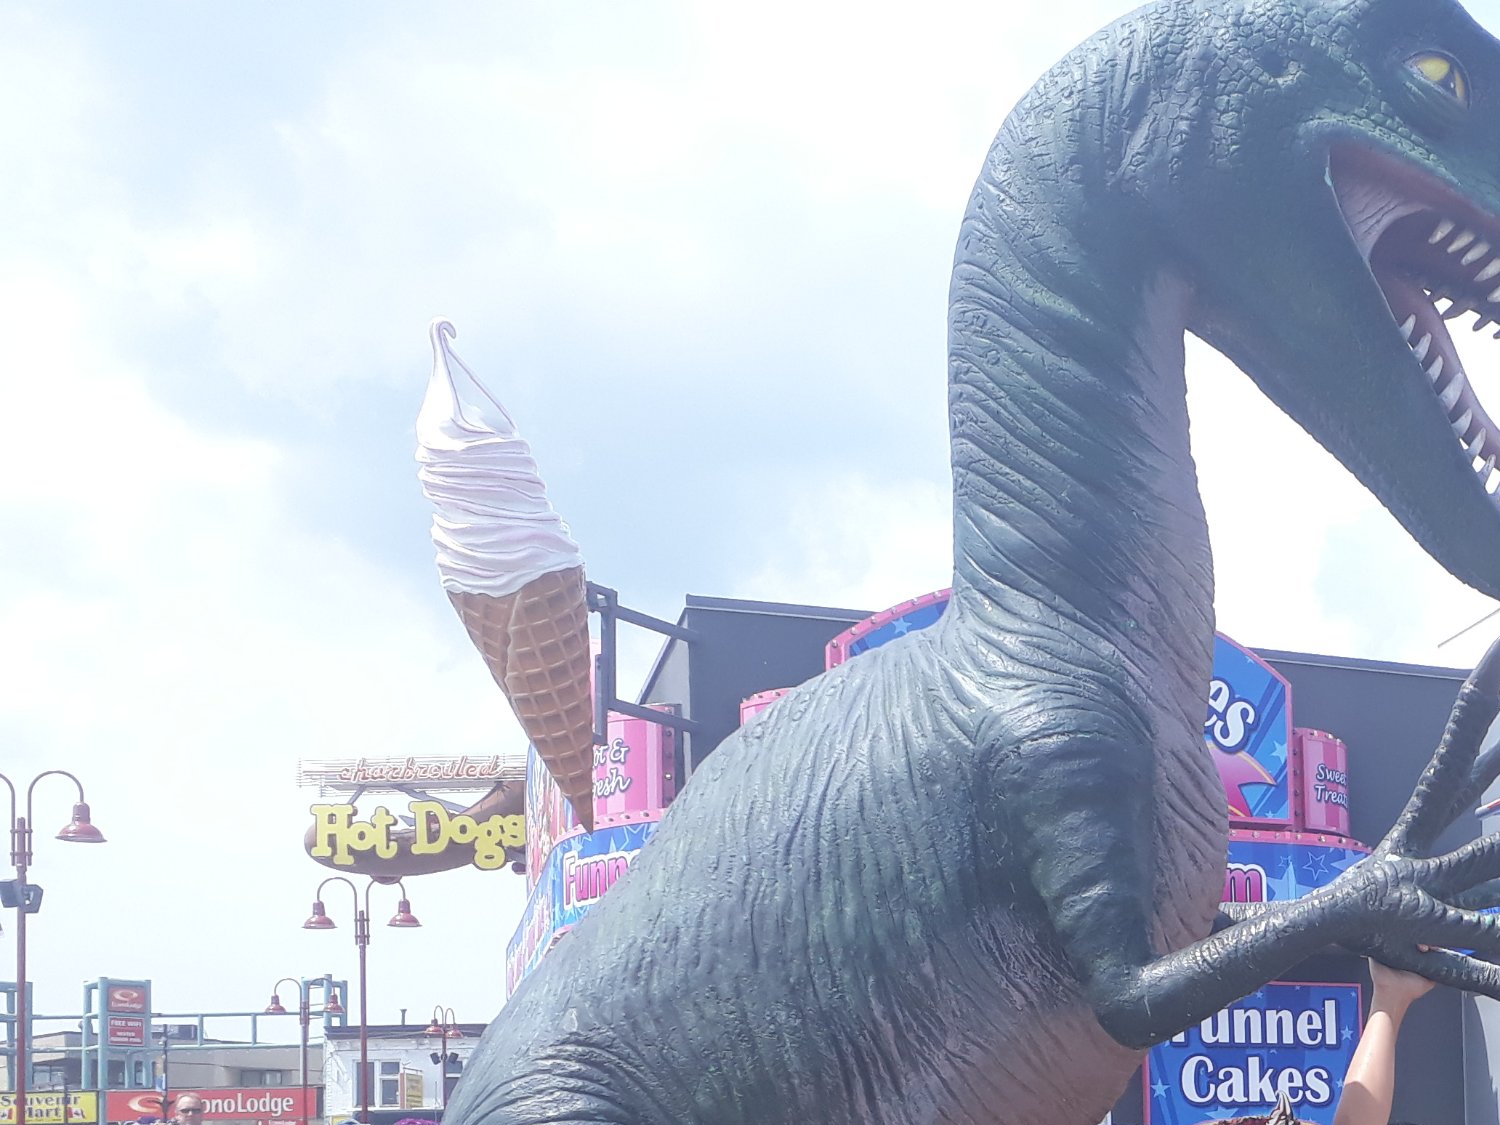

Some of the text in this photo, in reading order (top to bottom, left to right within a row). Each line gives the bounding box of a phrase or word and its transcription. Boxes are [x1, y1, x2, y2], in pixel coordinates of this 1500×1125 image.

[310, 801, 526, 870] Hot Dogs
[1181, 1055, 1330, 1104] Cakes
[202, 1092, 294, 1117] onoLodge
